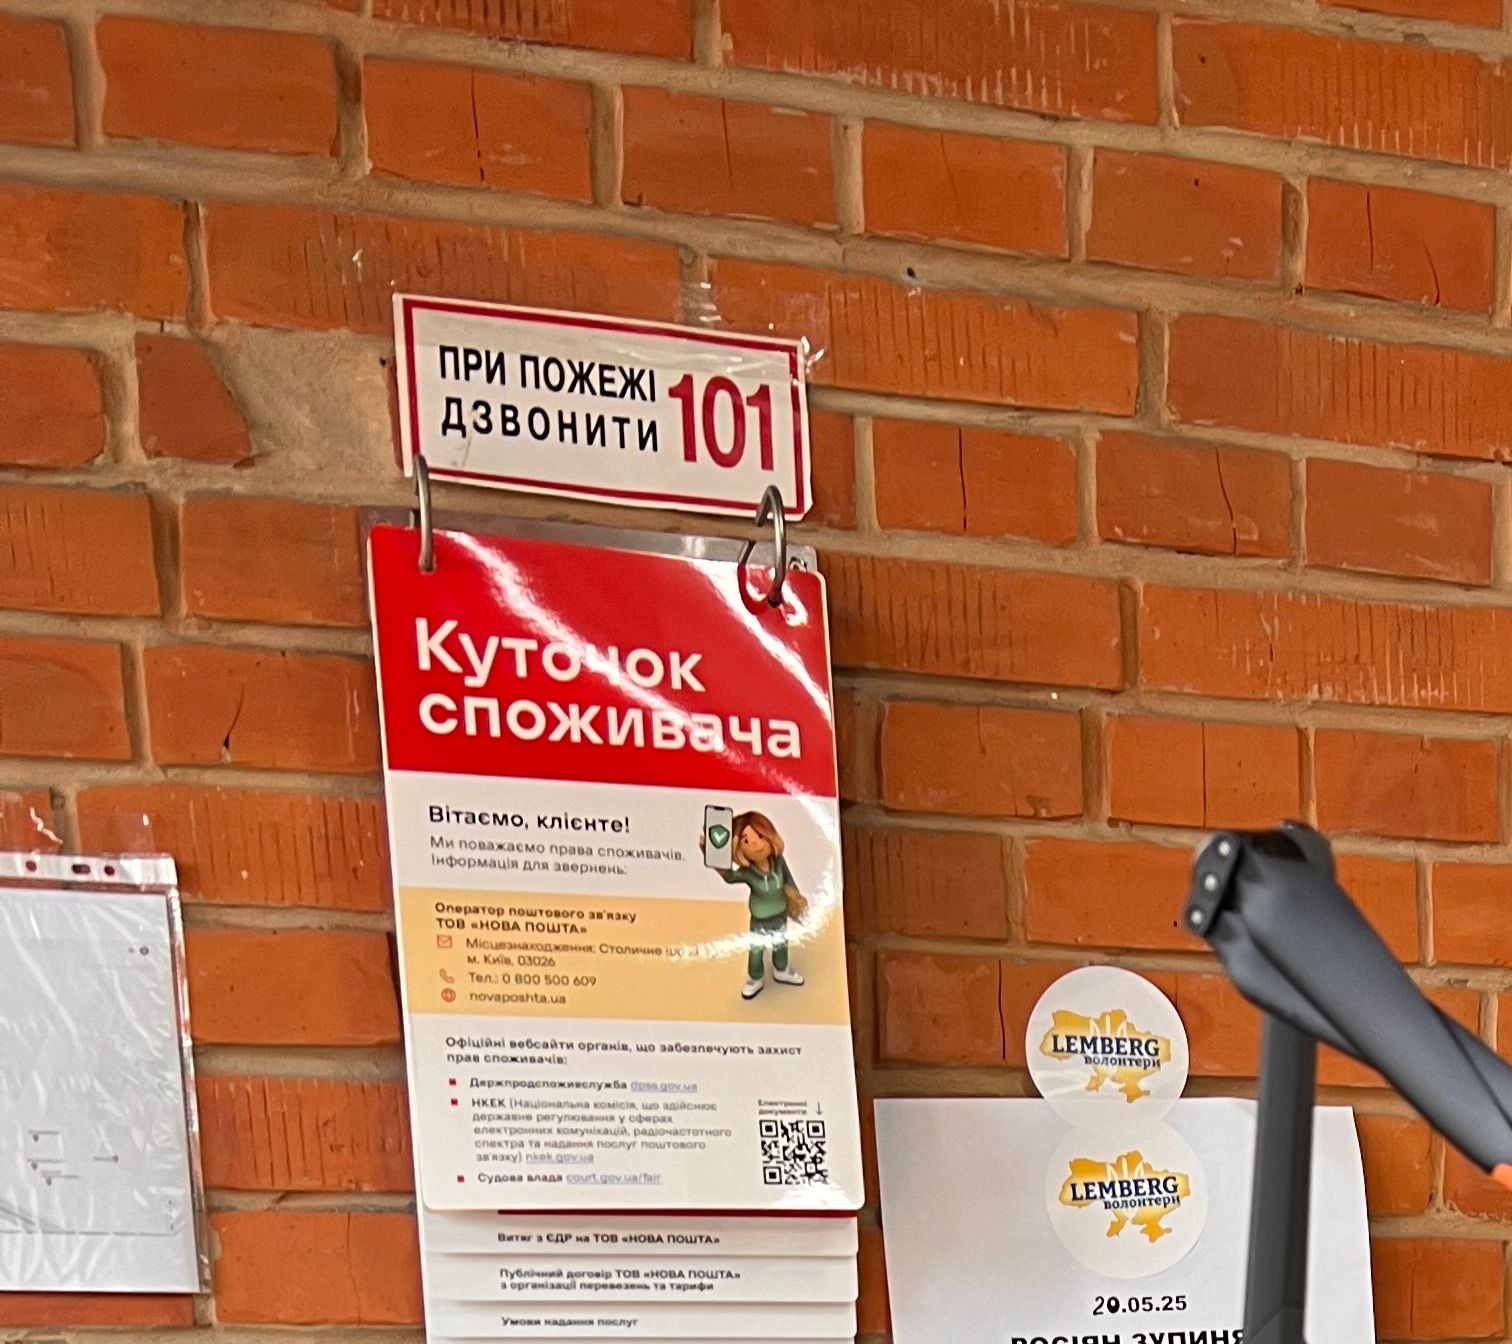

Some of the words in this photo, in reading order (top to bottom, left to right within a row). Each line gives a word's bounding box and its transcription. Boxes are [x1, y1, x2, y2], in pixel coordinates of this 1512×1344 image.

[438, 345, 505, 385] ПРИ
[520, 354, 656, 402] ПОЖЕЖІ
[441, 397, 659, 452] ДЗВОНИТИ
[667, 374, 775, 471] 101
[415, 617, 705, 692] Куточок
[419, 693, 800, 758] споживача
[429, 805, 529, 829] Вітаємо,
[537, 812, 630, 833] клієнте!
[430, 836, 454, 848] Ми
[459, 838, 545, 854] поважаємо
[550, 844, 593, 857] права
[431, 855, 518, 869] Інформація
[523, 861, 549, 871] для
[435, 903, 504, 917] Оператор
[509, 908, 584, 919] поштового
[437, 919, 465, 930] ТОВ
[471, 920, 521, 932] «НОВА
[525, 922, 587, 934] ПОШТА»
[599, 944, 662, 955] Столичне
[518, 956, 555, 967] 03026
[503, 974, 510, 984] 0
[515, 974, 540, 985] 800
[545, 975, 569, 985] 500
[573, 976, 596, 986] 609
[470, 991, 566, 1004] novaposhta.ua
[446, 1037, 505, 1050] Офіційні
[510, 1038, 574, 1050] вебсайти
[636, 1043, 655, 1052] що
[660, 1042, 753, 1055] забезпечують
[758, 1046, 802, 1055] захист
[1052, 1034, 1160, 1056] LEMBERG
[447, 1054, 479, 1065] прав
[1084, 1056, 1161, 1070] волонтери
[472, 1098, 506, 1108] НКЕК
[478, 1173, 523, 1184] Судова
[527, 1173, 562, 1183] влада
[1070, 1176, 1178, 1201] LEMBERG
[1103, 1194, 1180, 1210] волонтери
[594, 1234, 618, 1243] ТОВ
[616, 1270, 640, 1278] ТОВ
[1093, 1295, 1187, 1315] 20.05.25
